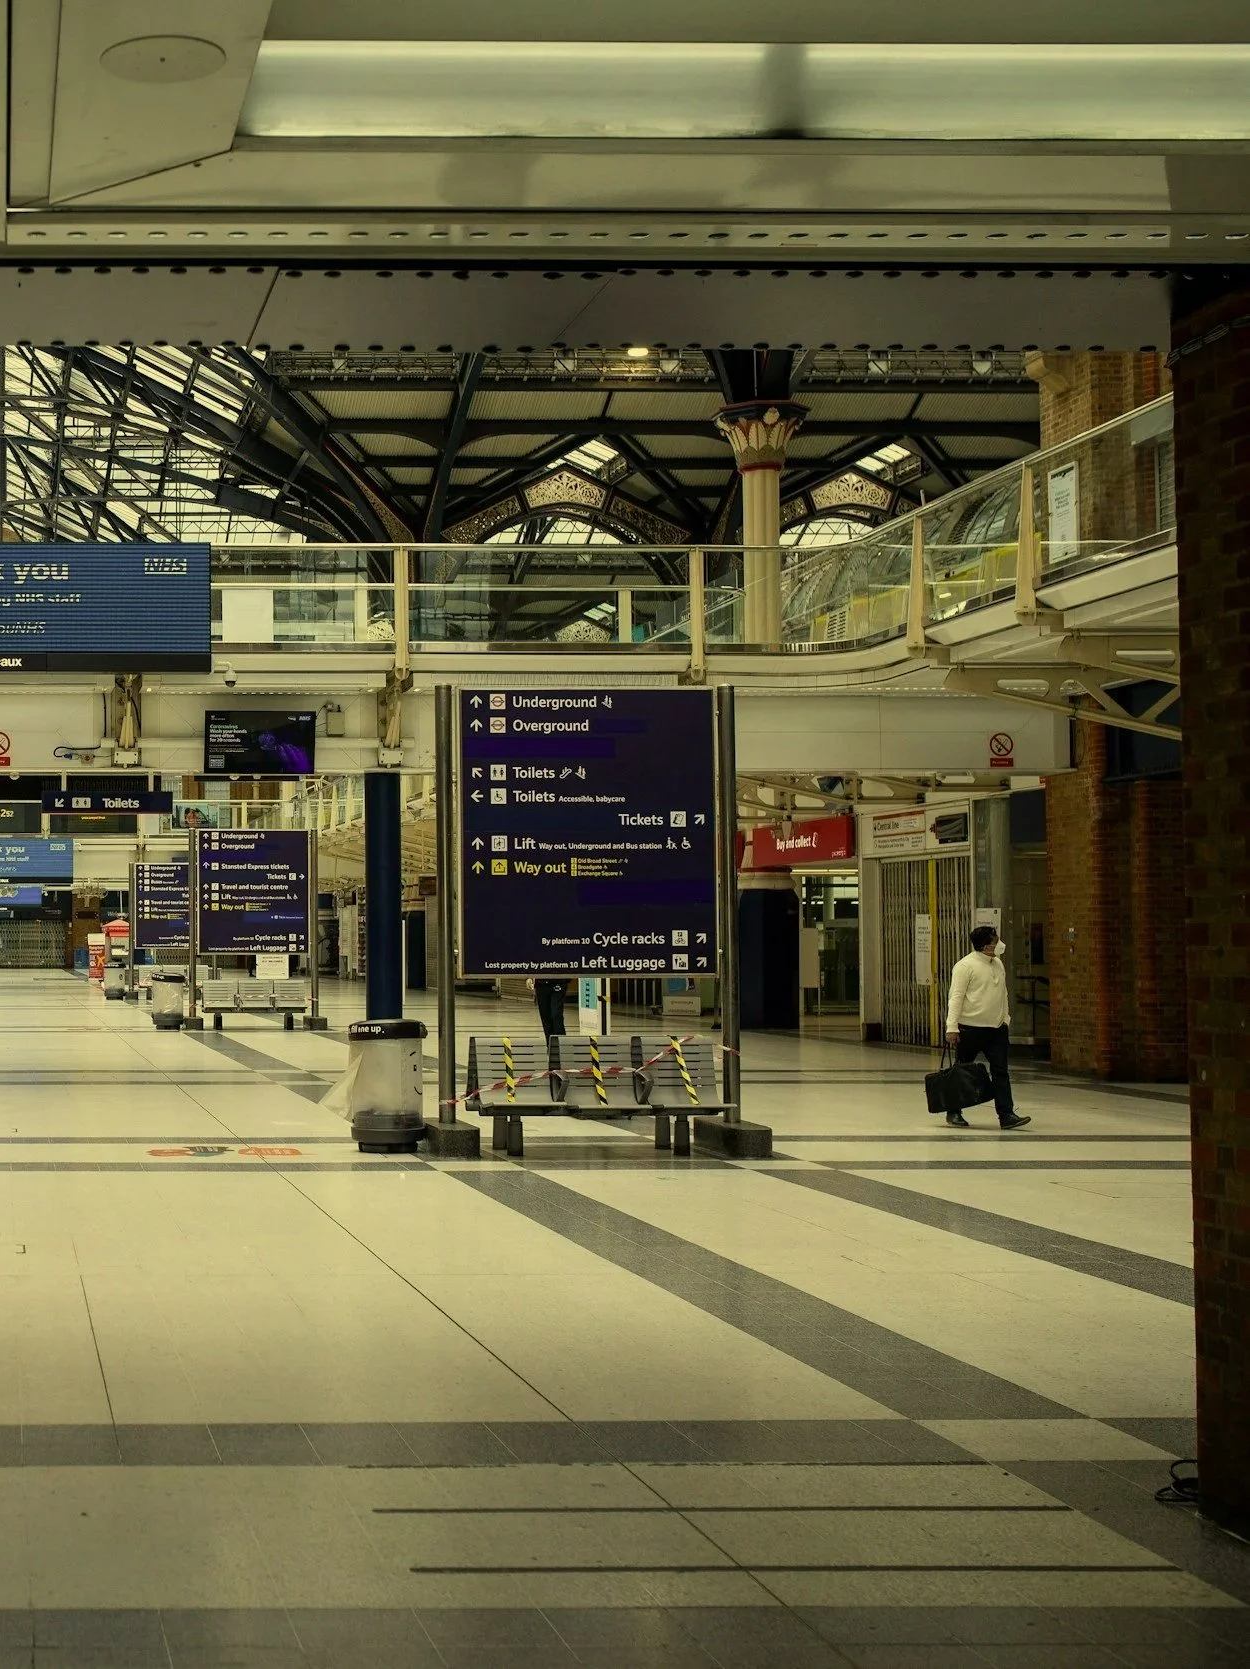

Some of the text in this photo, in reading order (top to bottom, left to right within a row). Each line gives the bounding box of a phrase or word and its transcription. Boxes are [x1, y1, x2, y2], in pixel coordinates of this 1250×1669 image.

[13, 563, 69, 584] you
[15, 593, 44, 603] NHS
[513, 696, 597, 710] Underground
[513, 719, 589, 734] Overground
[513, 766, 555, 779] Toilets
[102, 797, 140, 809] Toilets
[513, 790, 626, 804] Toilets Accessible, babycare
[618, 813, 664, 826] Tickets
[221, 833, 259, 841] Underground
[4, 845, 26, 855] you
[221, 843, 255, 851] Overground
[514, 838, 536, 850] Lift
[538, 842, 553, 851] Way
[554, 842, 567, 851] out,
[568, 842, 611, 851] Underground
[776, 835, 811, 853] Buy and collect
[247, 863, 269, 871] Express
[514, 861, 541, 876] Way
[544, 862, 567, 874] out
[254, 934, 271, 942] Cycle
[541, 932, 665, 947] By platform 10 Cycle racks
[262, 944, 287, 952] Luggage
[484, 961, 499, 969] Lost
[500, 962, 529, 970] property
[530, 961, 538, 970] by
[539, 961, 568, 970] platform
[581, 956, 607, 969] Left
[610, 956, 666, 972] Luggage
[370, 1025, 386, 1035] up.
